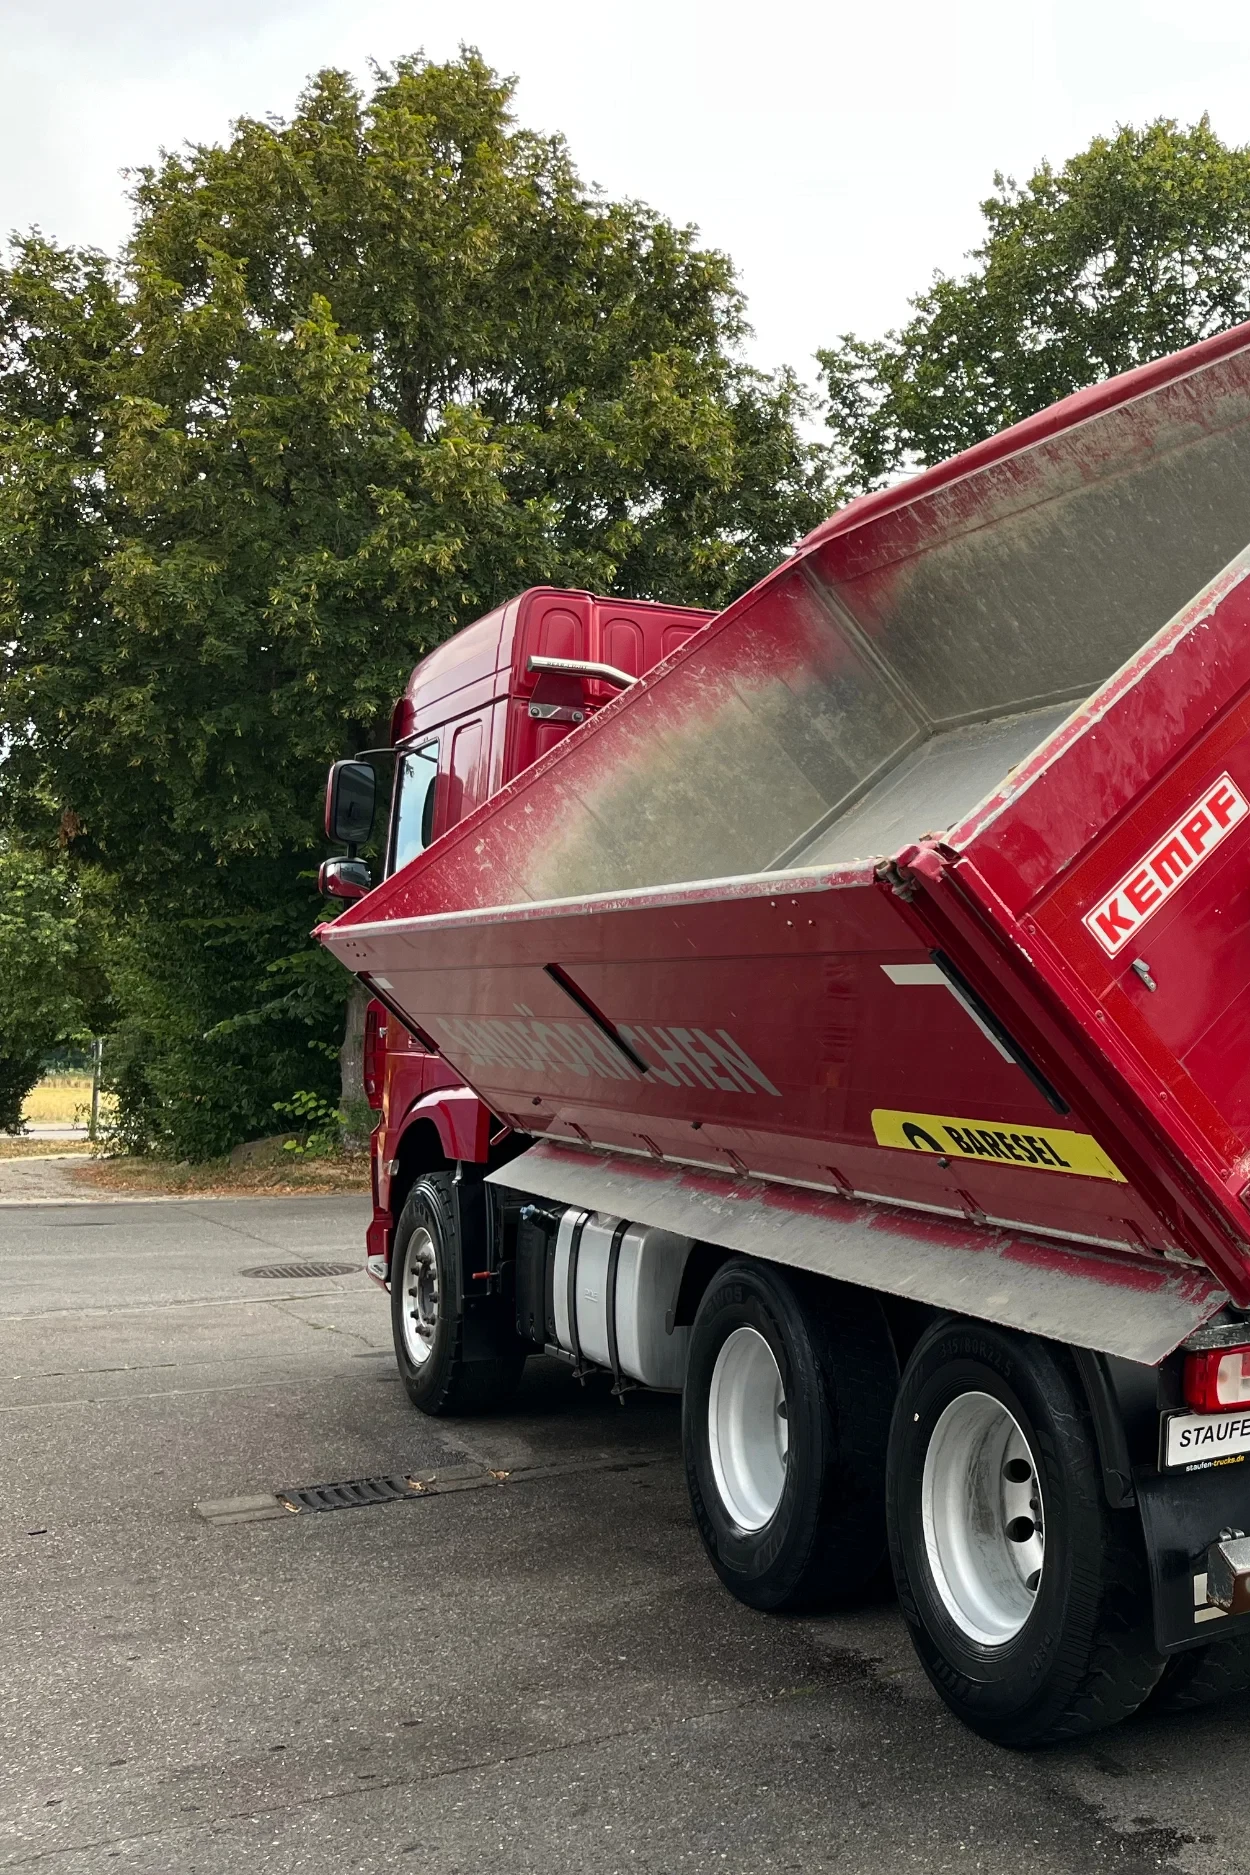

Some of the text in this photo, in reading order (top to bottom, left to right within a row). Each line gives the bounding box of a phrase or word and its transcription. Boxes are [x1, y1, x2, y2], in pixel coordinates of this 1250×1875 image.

[1095, 785, 1236, 945] KEMPF
[942, 1125, 1072, 1168] BARESEL
[1185, 1455, 1245, 1472] staufen-trucks.de
